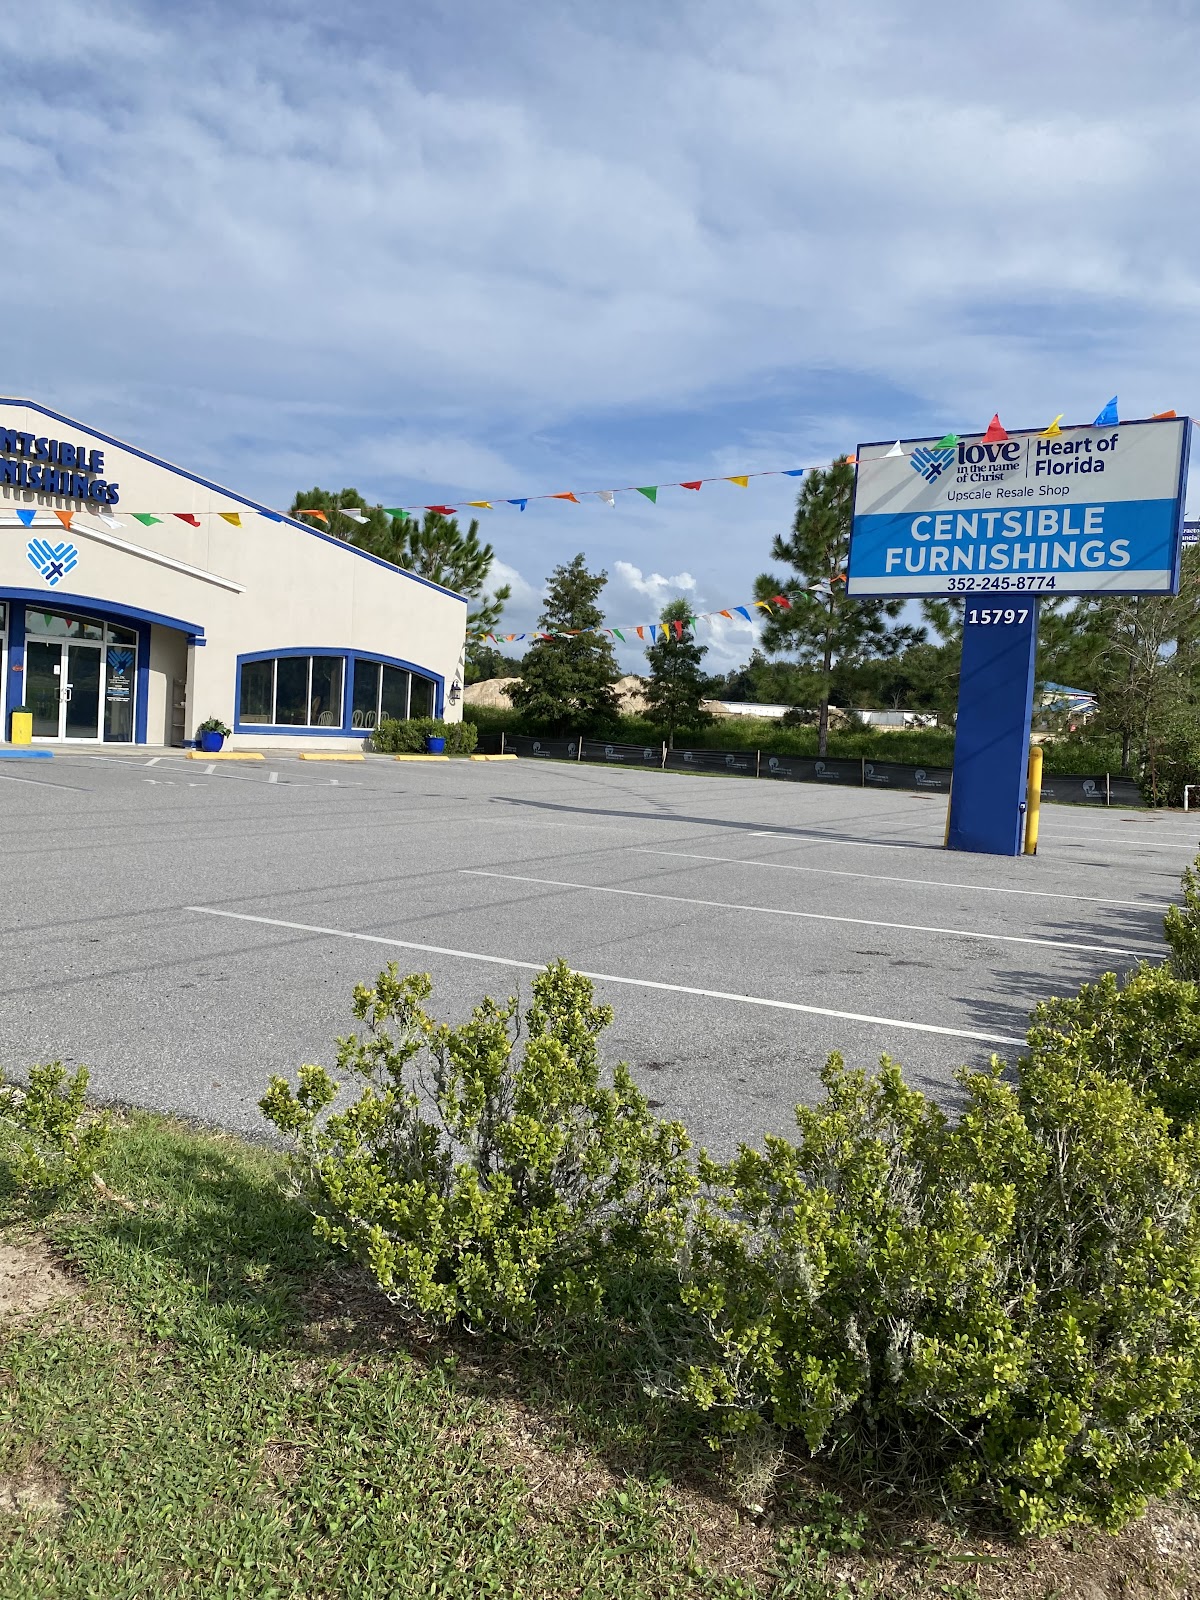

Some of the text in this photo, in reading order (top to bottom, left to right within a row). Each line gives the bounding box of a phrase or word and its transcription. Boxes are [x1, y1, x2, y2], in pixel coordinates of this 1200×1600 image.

[957, 441, 1020, 465] love
[1036, 433, 1119, 457] Heart of
[957, 462, 1020, 474] in the name
[1035, 456, 1105, 477] Florida
[956, 471, 1005, 483] of Christ
[947, 484, 1070, 502] Upscale Resale Shop
[911, 506, 1105, 542] CENTSIBLE
[885, 538, 1131, 573] FURNISHINGS
[947, 575, 1056, 591] 352-245-8774
[968, 609, 1029, 625] 15797
